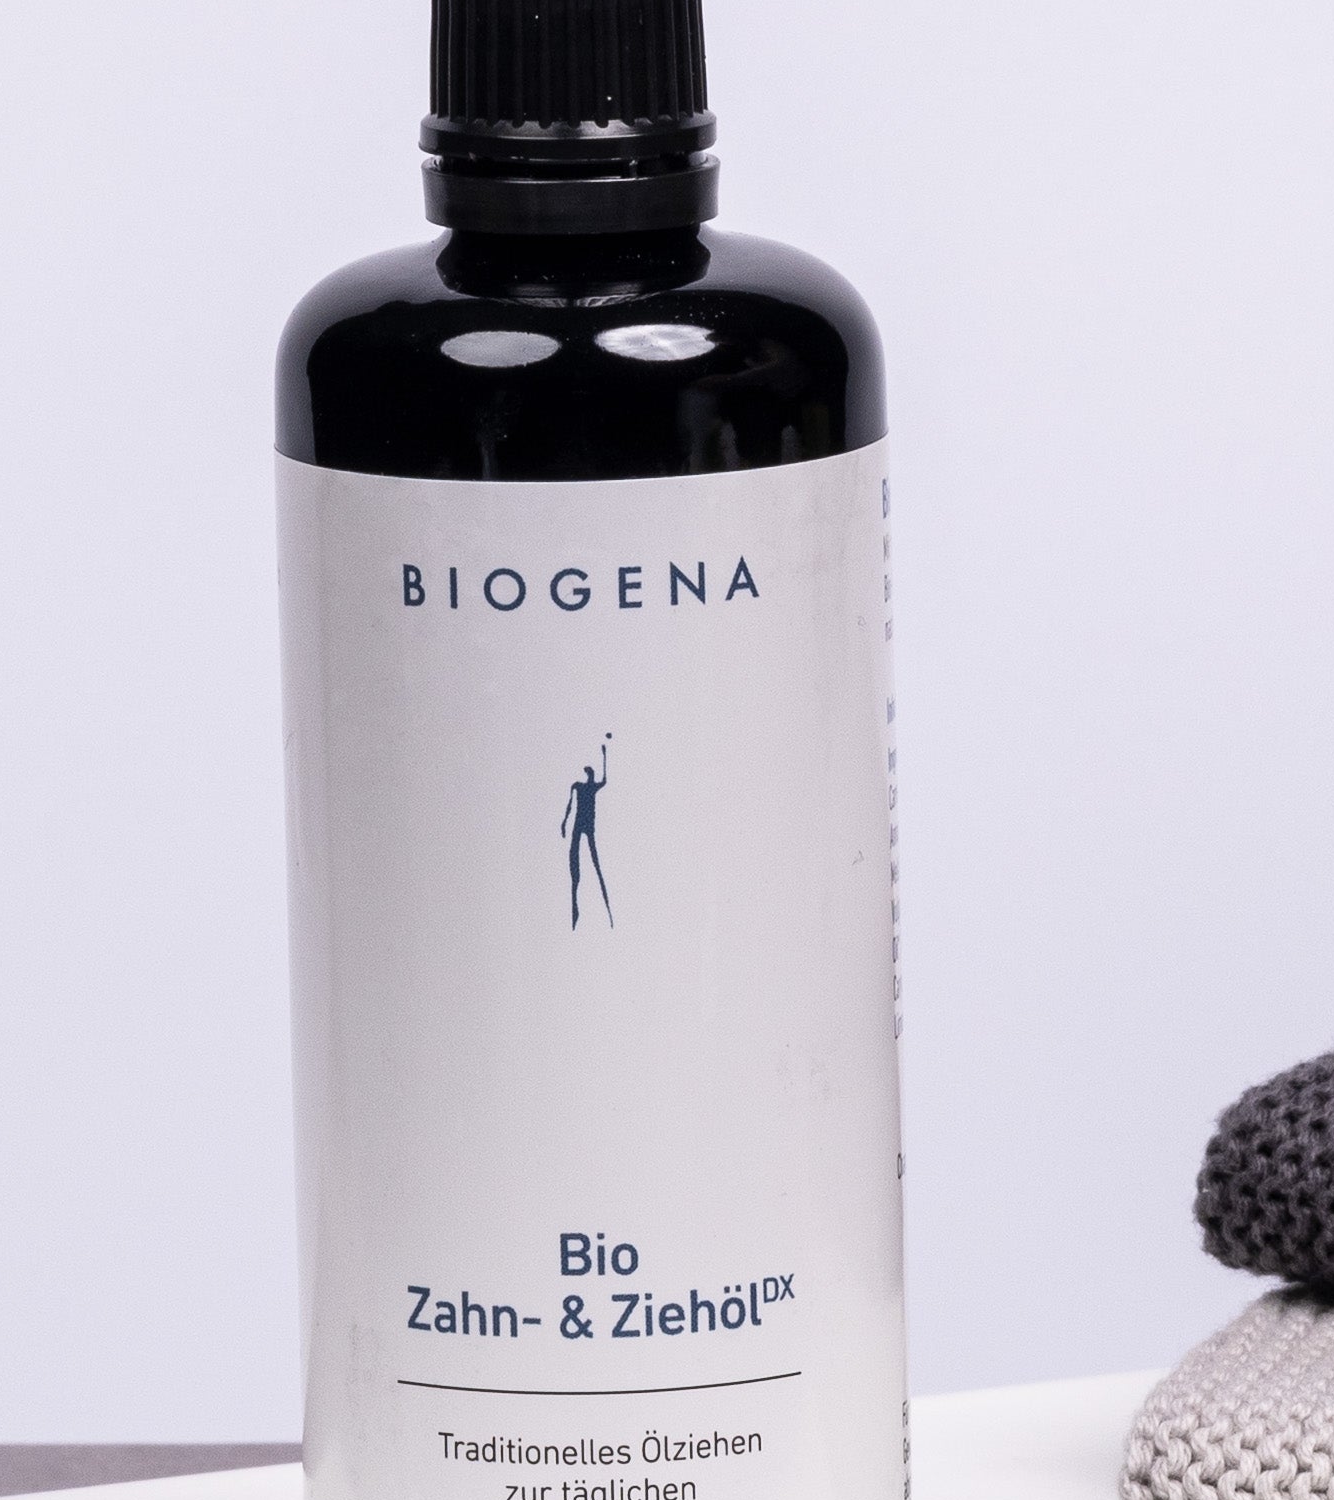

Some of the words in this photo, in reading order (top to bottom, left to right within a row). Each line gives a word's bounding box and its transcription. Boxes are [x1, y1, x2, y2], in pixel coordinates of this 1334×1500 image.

[402, 556, 760, 612] BIOGENA
[559, 1232, 640, 1276] Bio
[406, 1285, 542, 1338] Zahn-
[558, 1295, 595, 1340] &
[438, 1432, 632, 1466] Traditionelles
[641, 1430, 763, 1464] Ölziehen
